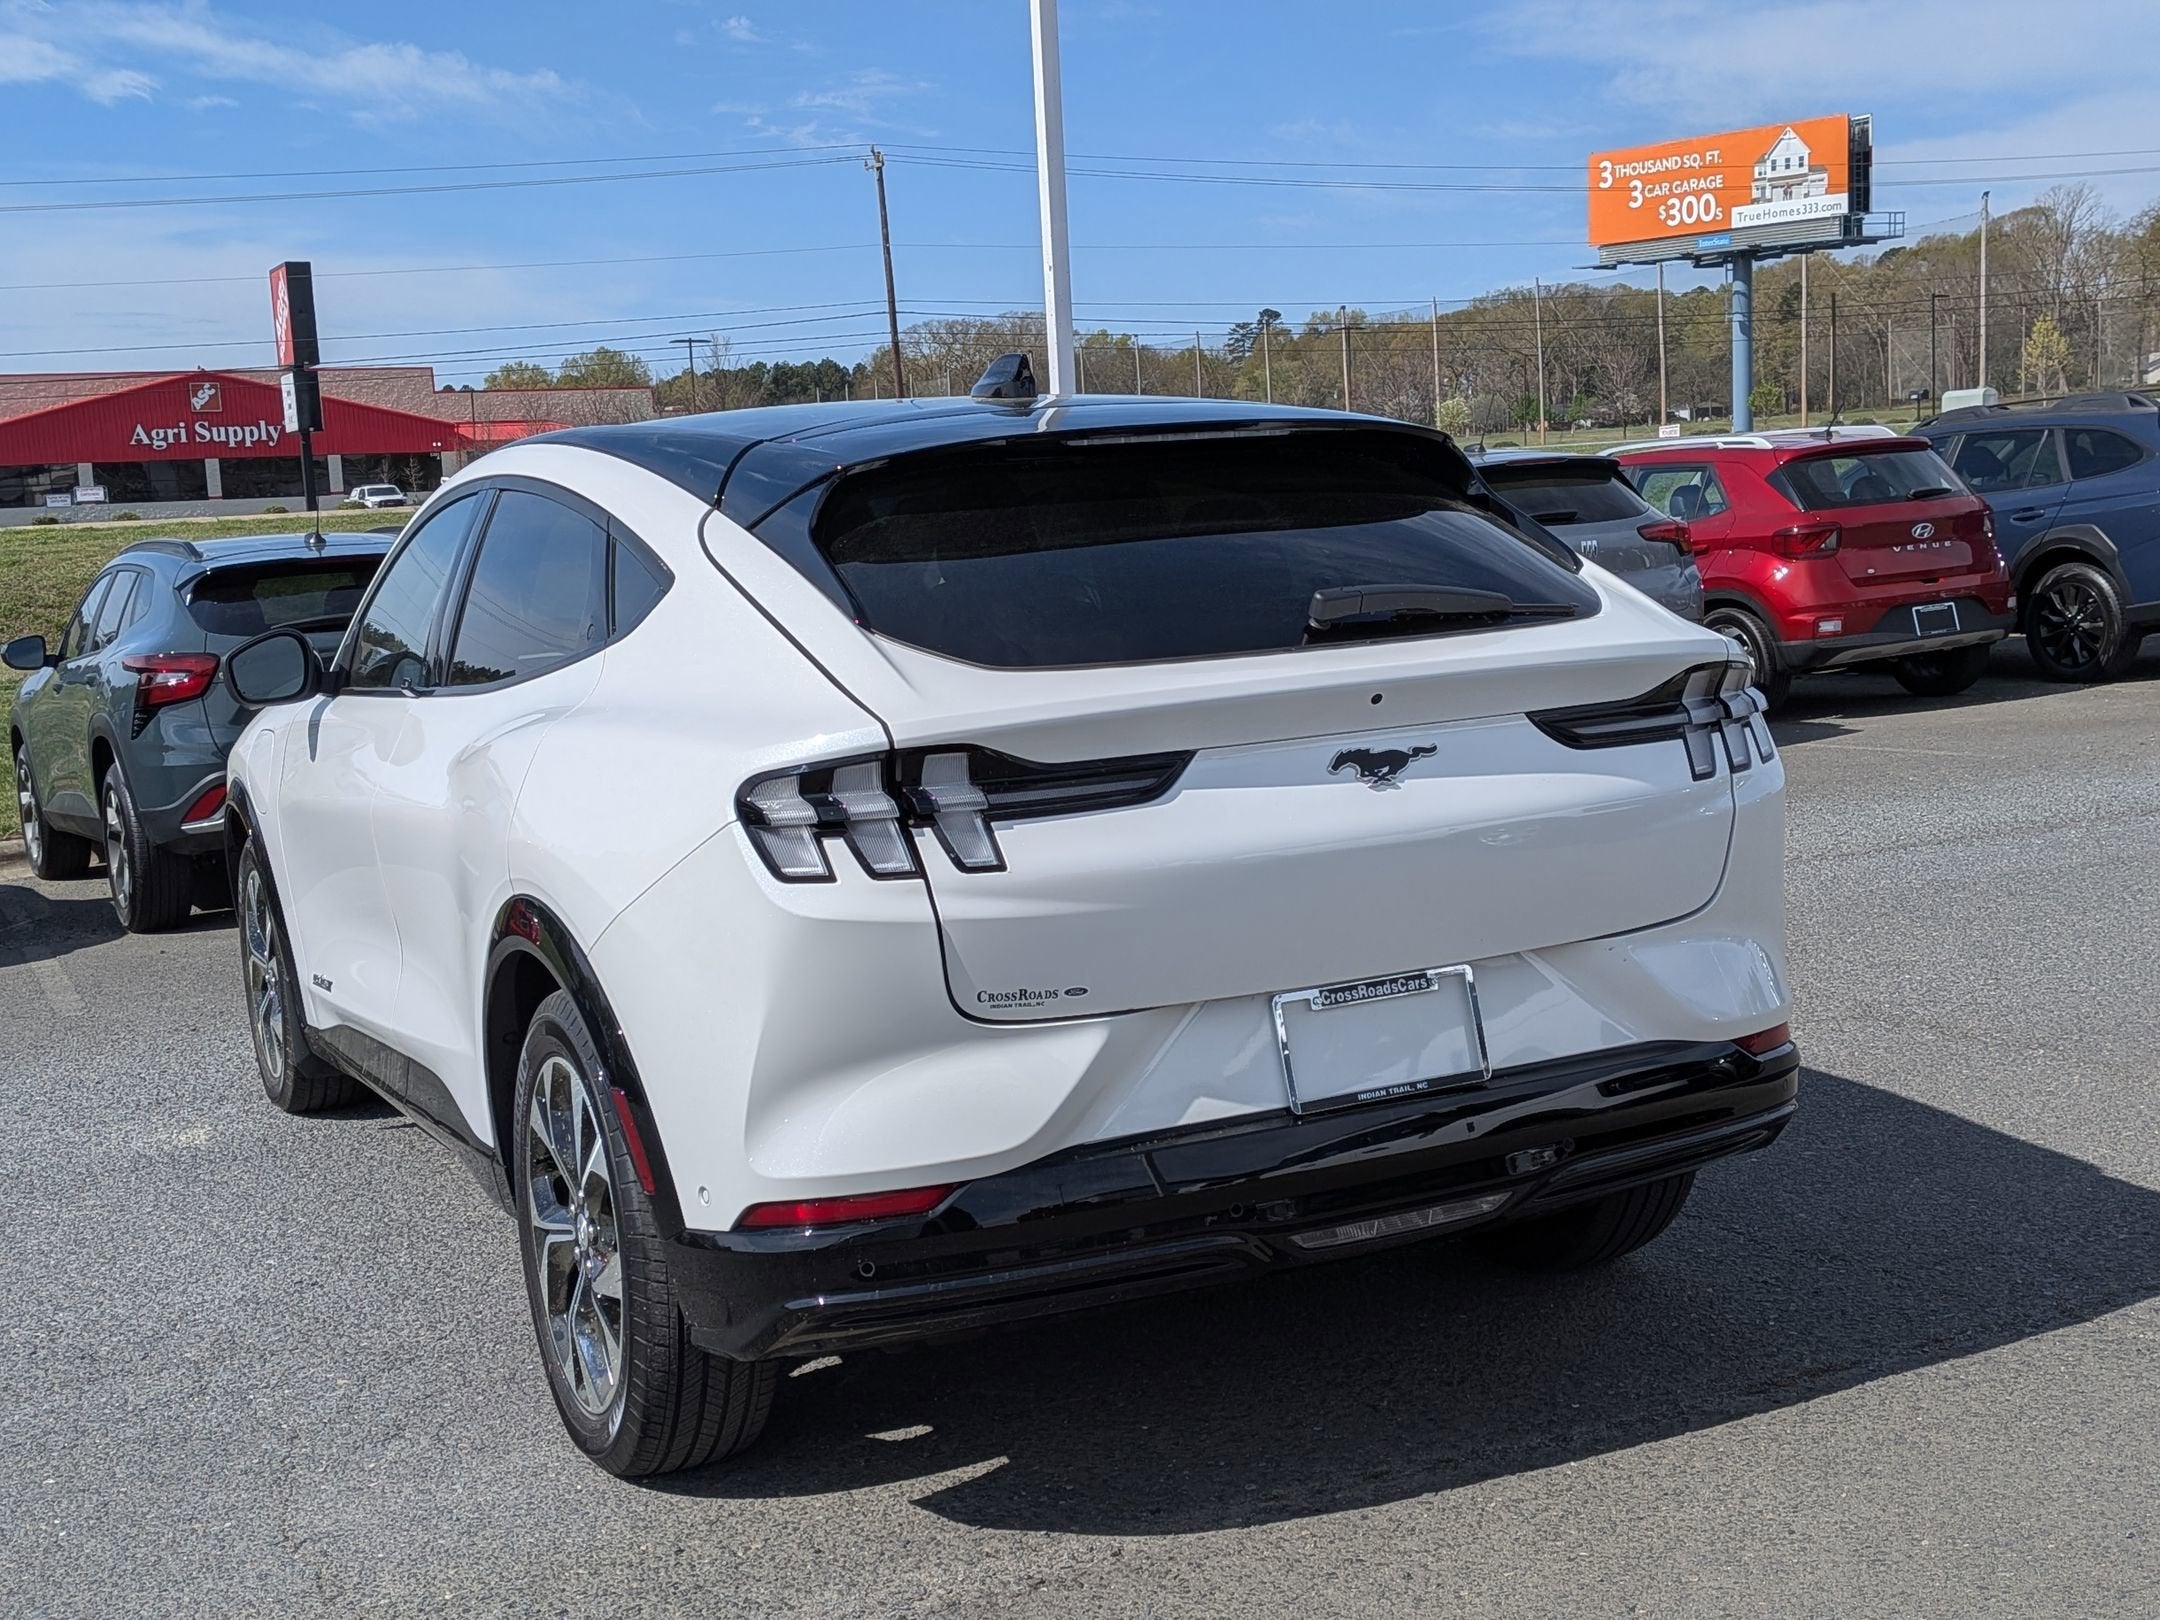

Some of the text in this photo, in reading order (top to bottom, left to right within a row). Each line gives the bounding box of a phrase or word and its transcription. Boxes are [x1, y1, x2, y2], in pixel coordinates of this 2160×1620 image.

[1599, 150, 1722, 188] 3 THOUSAND SQ. FT.
[1628, 175, 1723, 209] 3 CAR GARAGE
[1736, 201, 1842, 223] TrueHomes333.com
[191, 382, 216, 410] ASC
[129, 420, 281, 450] Agri Supply
[1892, 540, 1952, 552] VENUE
[1321, 977, 1428, 1005] CrossRoadsCars
[1357, 1089, 1387, 1101] INDIAN
[1416, 1081, 1429, 1089] NC
